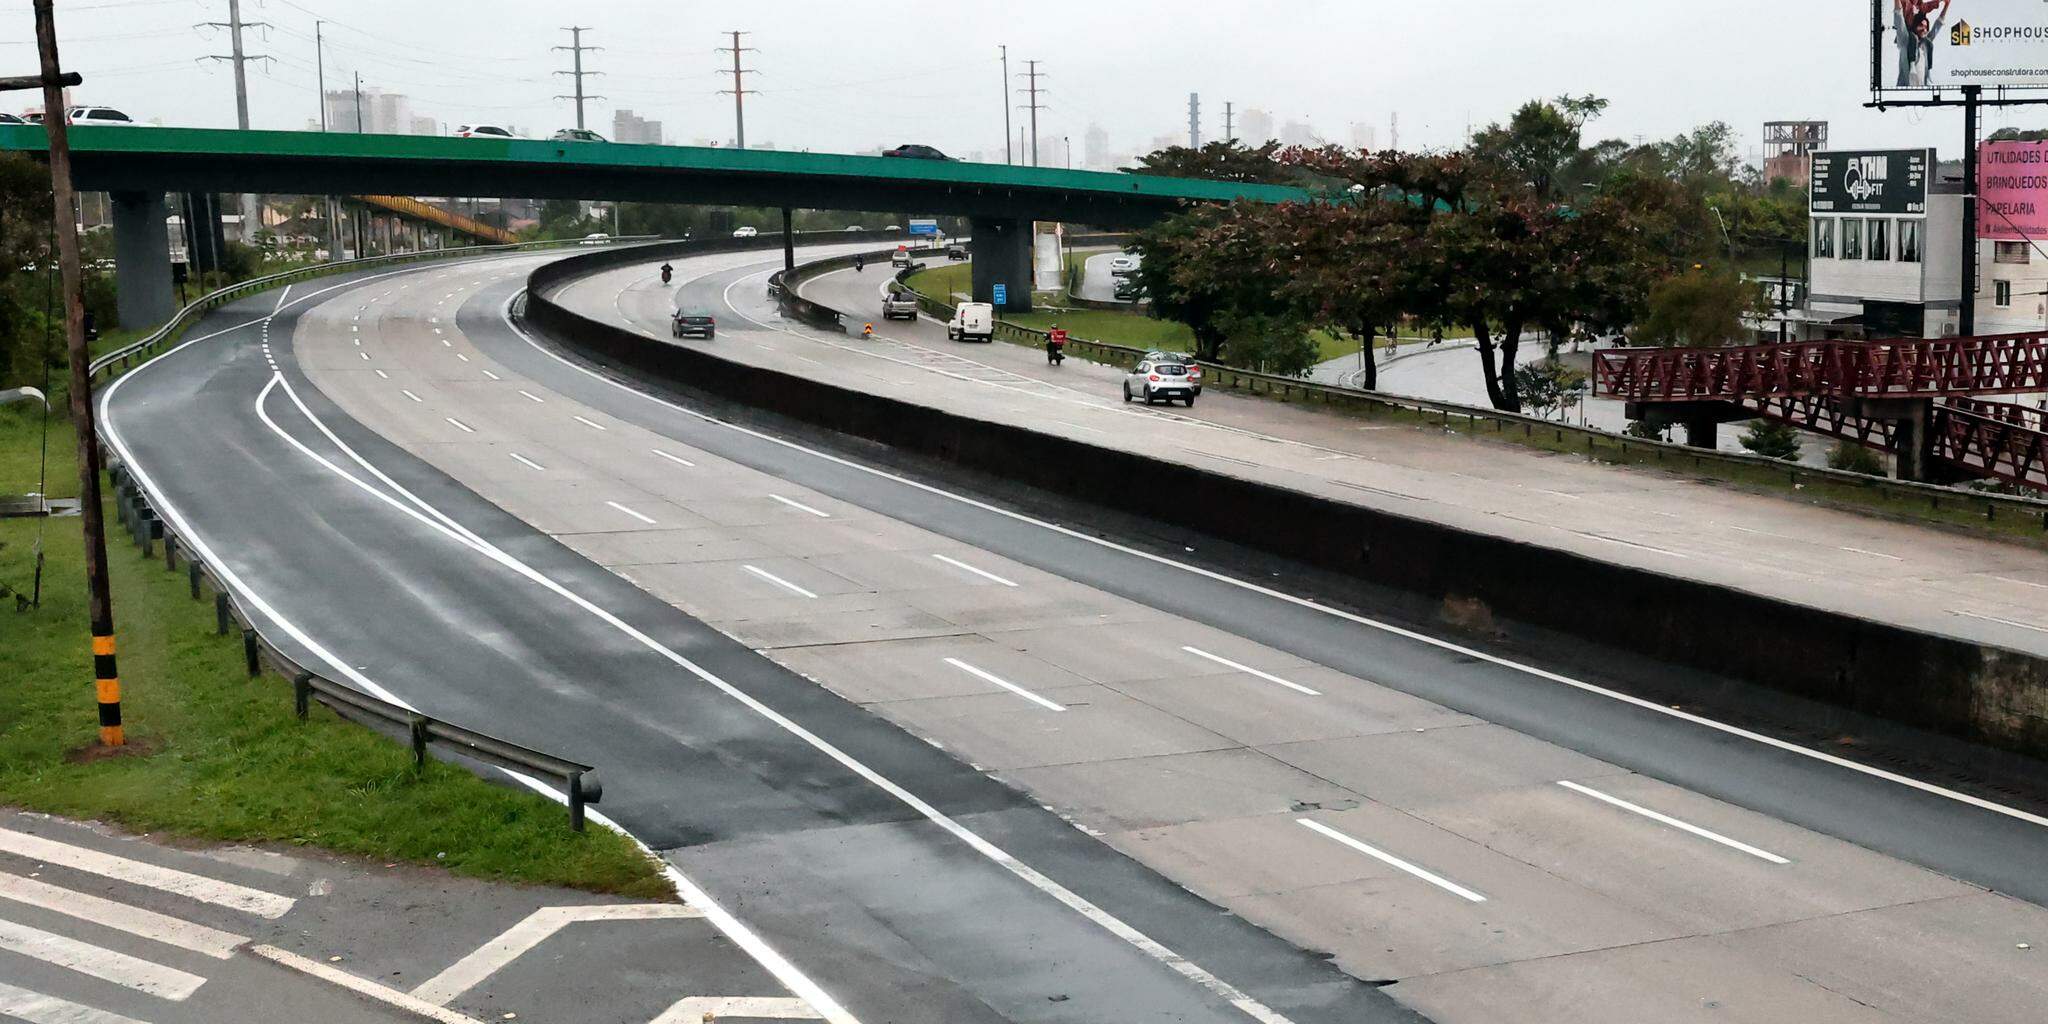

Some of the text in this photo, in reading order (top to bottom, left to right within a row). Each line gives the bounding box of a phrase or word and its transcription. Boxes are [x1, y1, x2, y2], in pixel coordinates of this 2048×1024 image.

[1988, 150, 2040, 164] UTILIDADES
[1987, 176, 2047, 189] BRINQUEDOS
[1871, 183, 1883, 195] FIT
[1986, 203, 2035, 215] PAPELARIA
